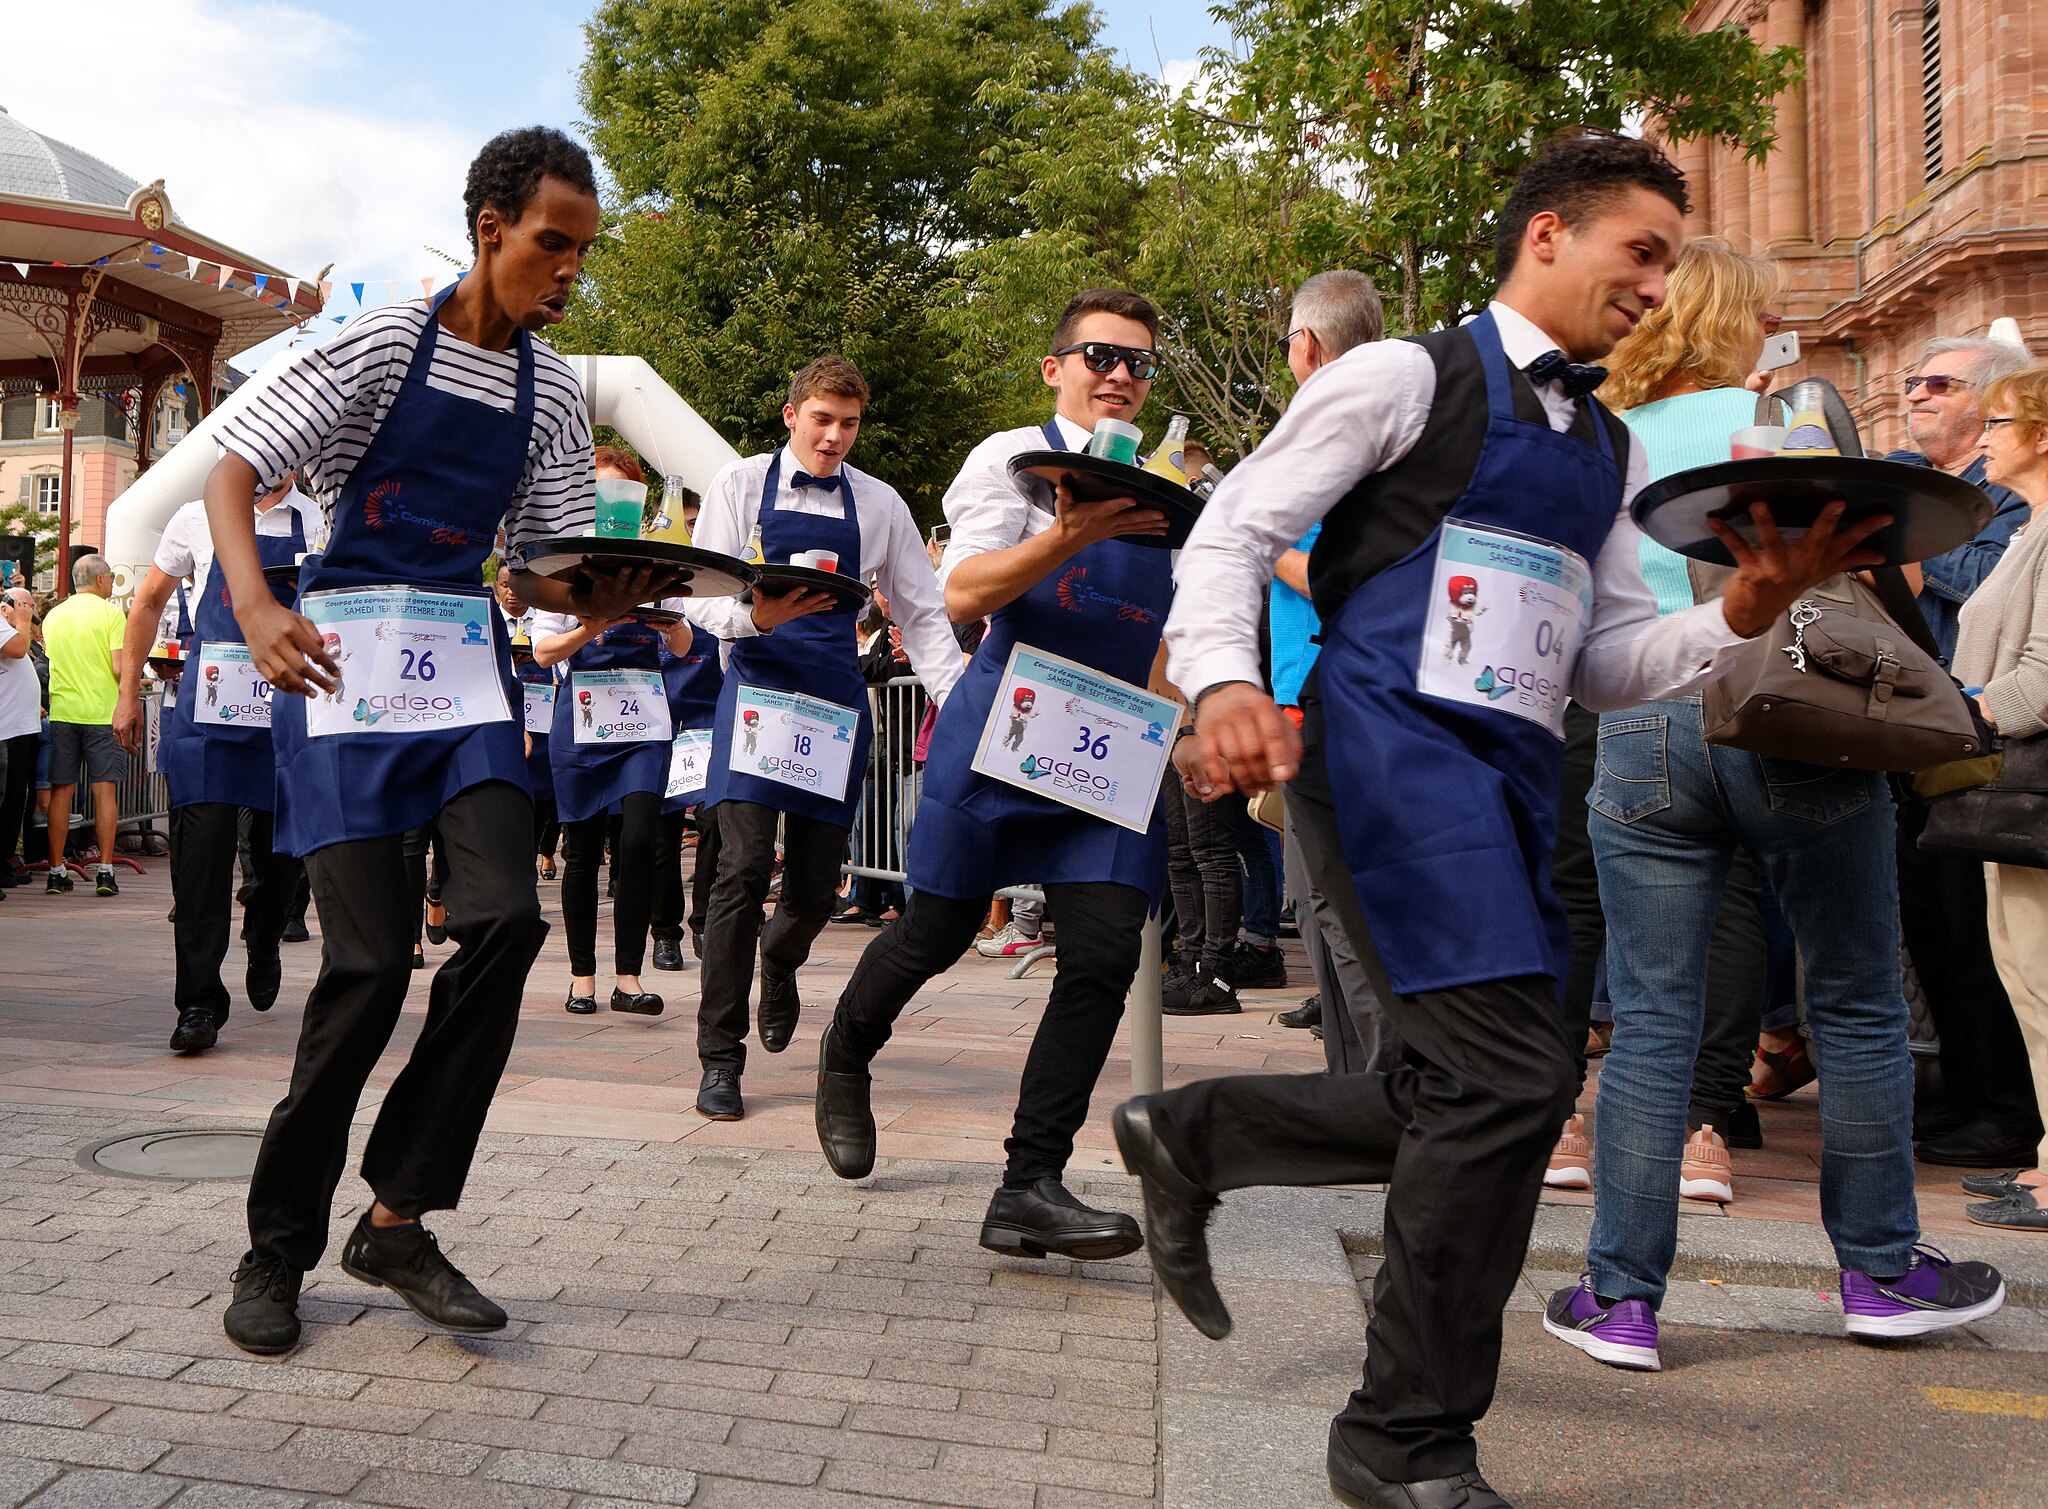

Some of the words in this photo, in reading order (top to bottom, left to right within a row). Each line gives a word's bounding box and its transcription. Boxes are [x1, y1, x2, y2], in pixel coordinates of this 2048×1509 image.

[325, 599, 352, 608] Course
[412, 598, 439, 606] garçons
[449, 600, 464, 608] café
[344, 605, 374, 616] SAMEDI
[379, 605, 392, 613] 1ER
[396, 605, 435, 616] SEPTEMBRE
[439, 608, 455, 617] 2018
[1535, 619, 1564, 665] 04
[401, 648, 435, 681] 26
[251, 680, 270, 698] 10
[1034, 661, 1058, 673] Course
[1058, 668, 1067, 676] de
[1067, 673, 1098, 688] serveuses
[1106, 687, 1131, 701] garçons
[1131, 695, 1140, 703] de
[1140, 699, 1155, 709] café
[1047, 673, 1073, 687] SAMEDI
[1076, 683, 1086, 692] 1ER
[1088, 688, 1125, 708] SEPTEMBRE
[1128, 702, 1144, 714] 2018
[369, 693, 452, 710] adeo
[457, 696, 465, 719] .com
[620, 699, 640, 716] 24
[394, 712, 454, 723] EXPO
[604, 722, 647, 732] adeo
[793, 733, 811, 757] 18
[1072, 726, 1111, 760] 36
[682, 756, 695, 771] 14
[768, 756, 817, 778] adeo
[1037, 757, 1109, 789] adeo
[671, 773, 702, 787] adeo
[780, 770, 815, 787] EXPO
[1053, 776, 1106, 801] EXPO
[1108, 781, 1120, 805] .com
